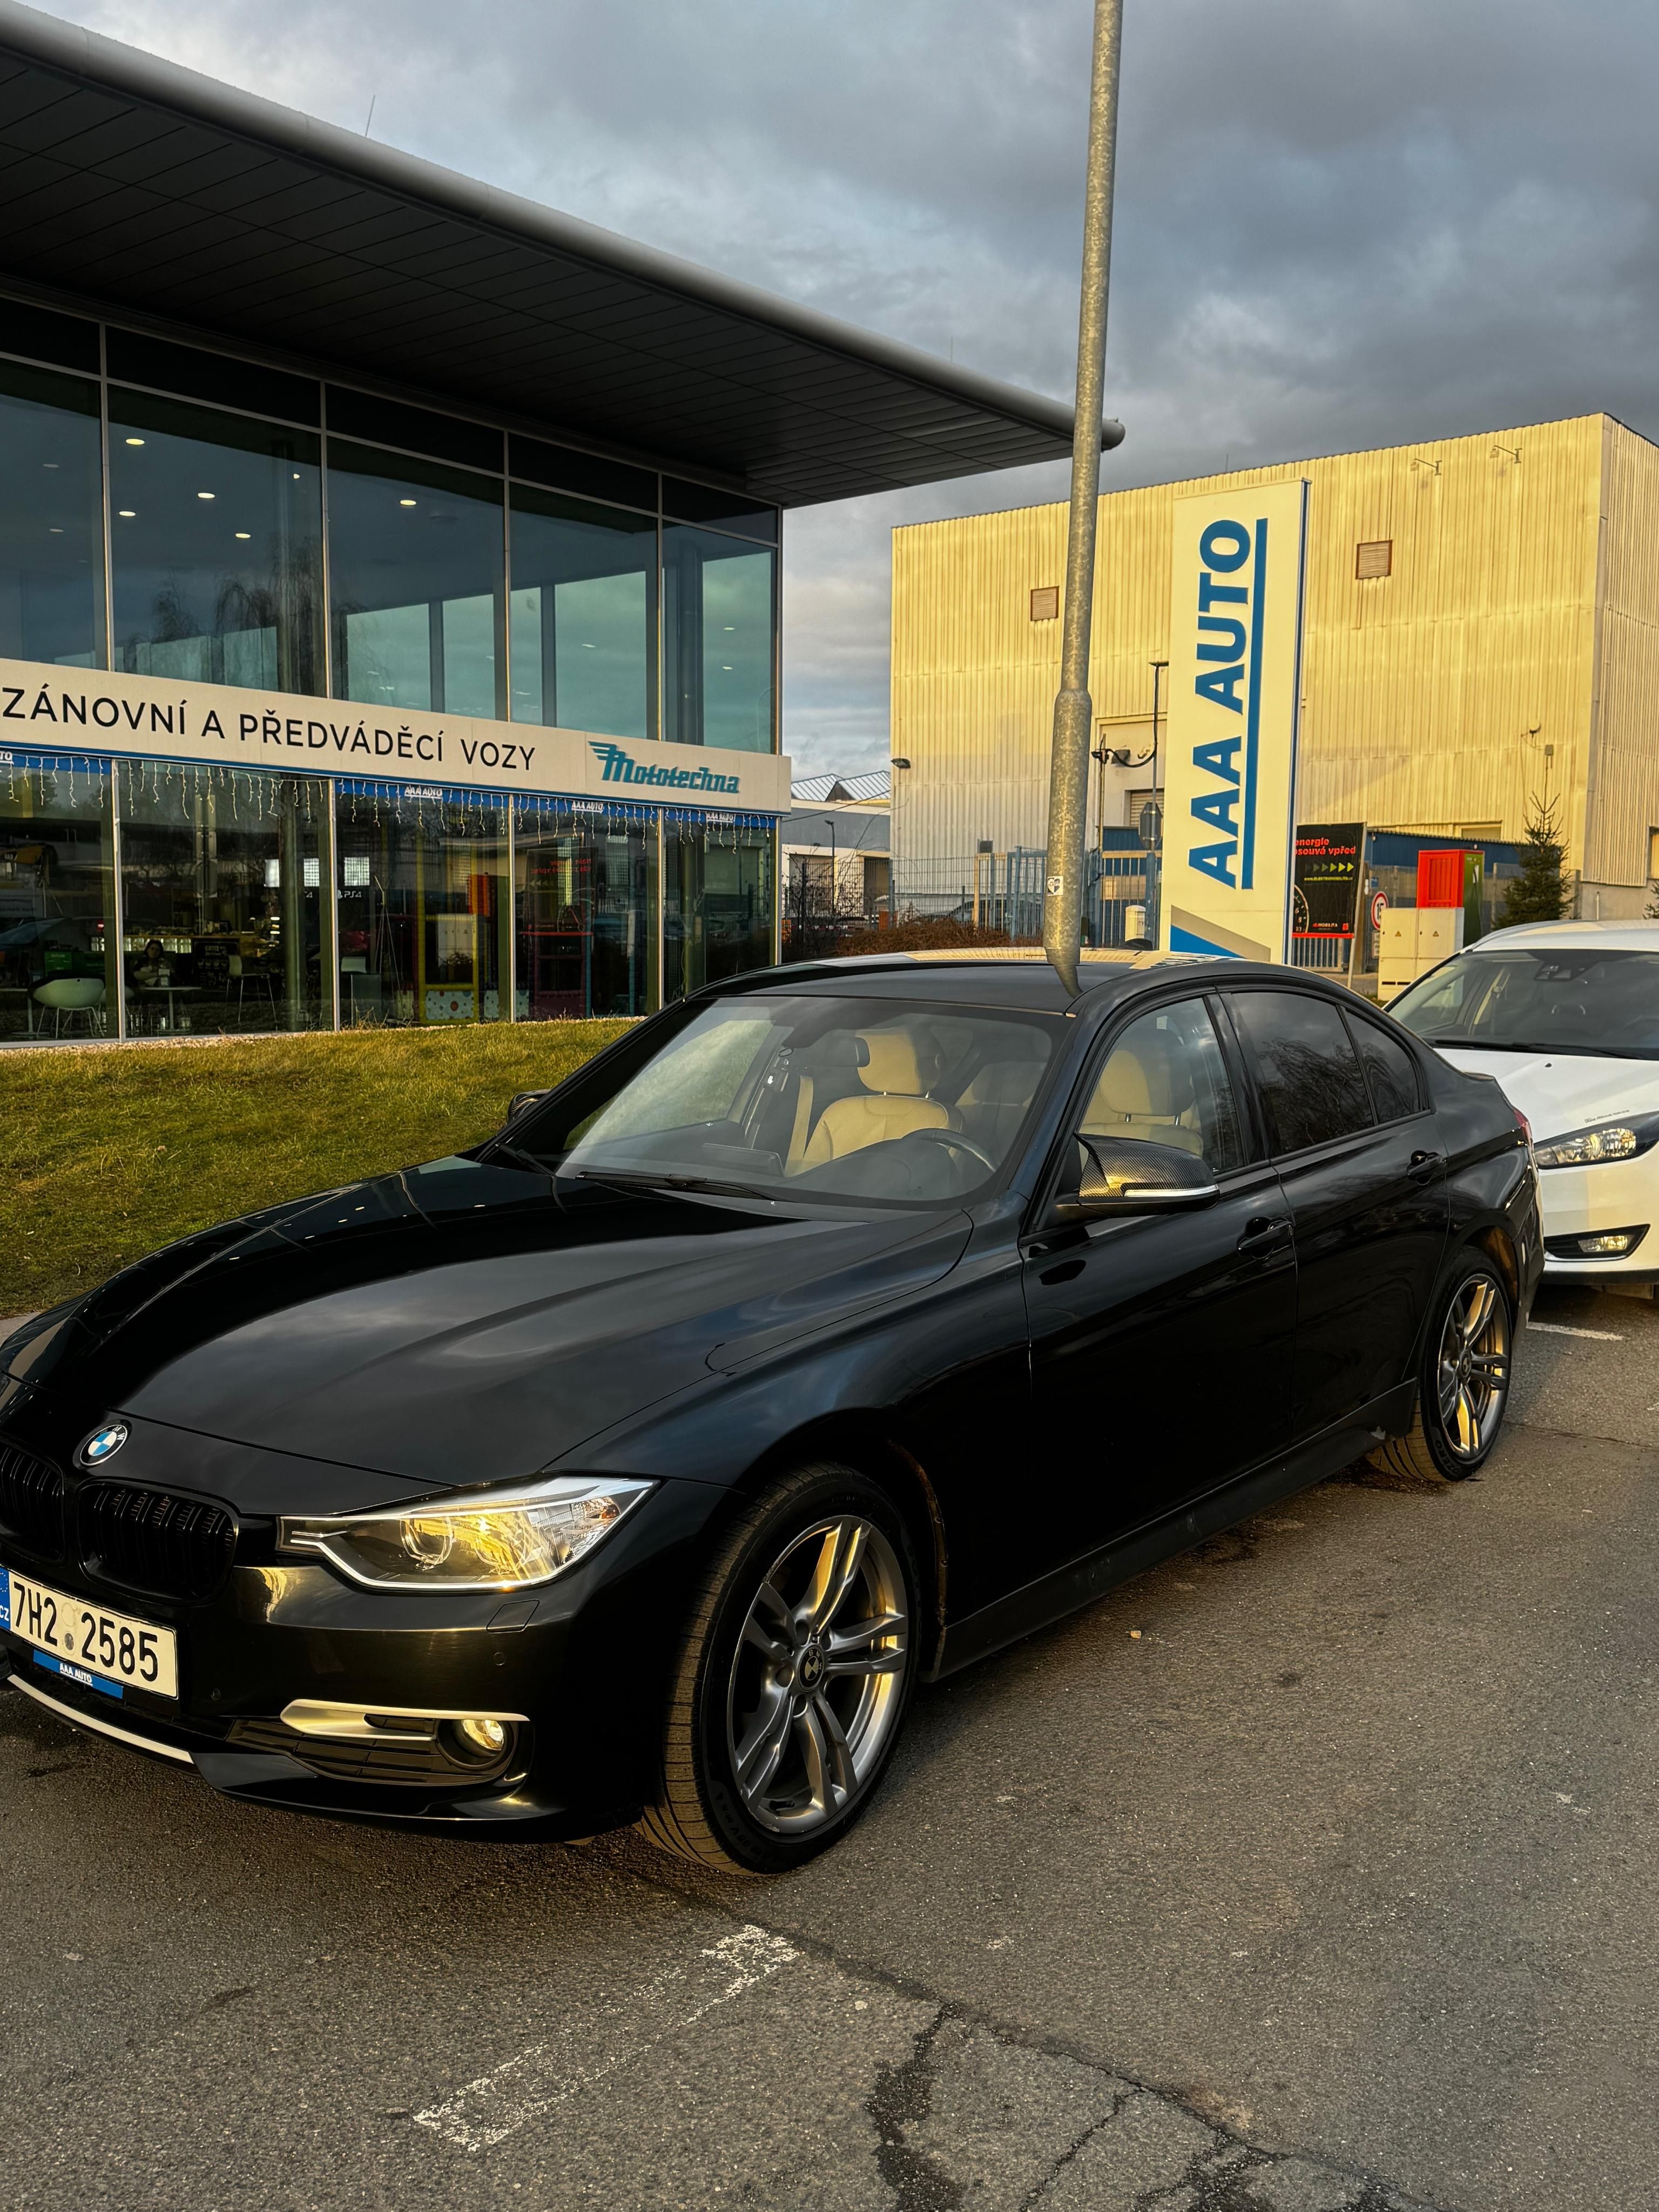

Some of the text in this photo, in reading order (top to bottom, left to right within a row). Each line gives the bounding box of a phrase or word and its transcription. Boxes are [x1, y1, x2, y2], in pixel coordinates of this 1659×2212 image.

[1189, 519, 1251, 889] AAA AUTO
[2, 683, 536, 771] ZÁNOVNÍ A PŘEDVÁDĚCÍ VOZY
[588, 741, 740, 794] Mototechna
[571, 800, 585, 810] AAA
[1328, 846, 1355, 855] vpřed
[0, 1604, 9, 1622] CZ
[14, 1581, 158, 1682] 7H2 2585
[60, 1663, 92, 1683] AAA AUTO
